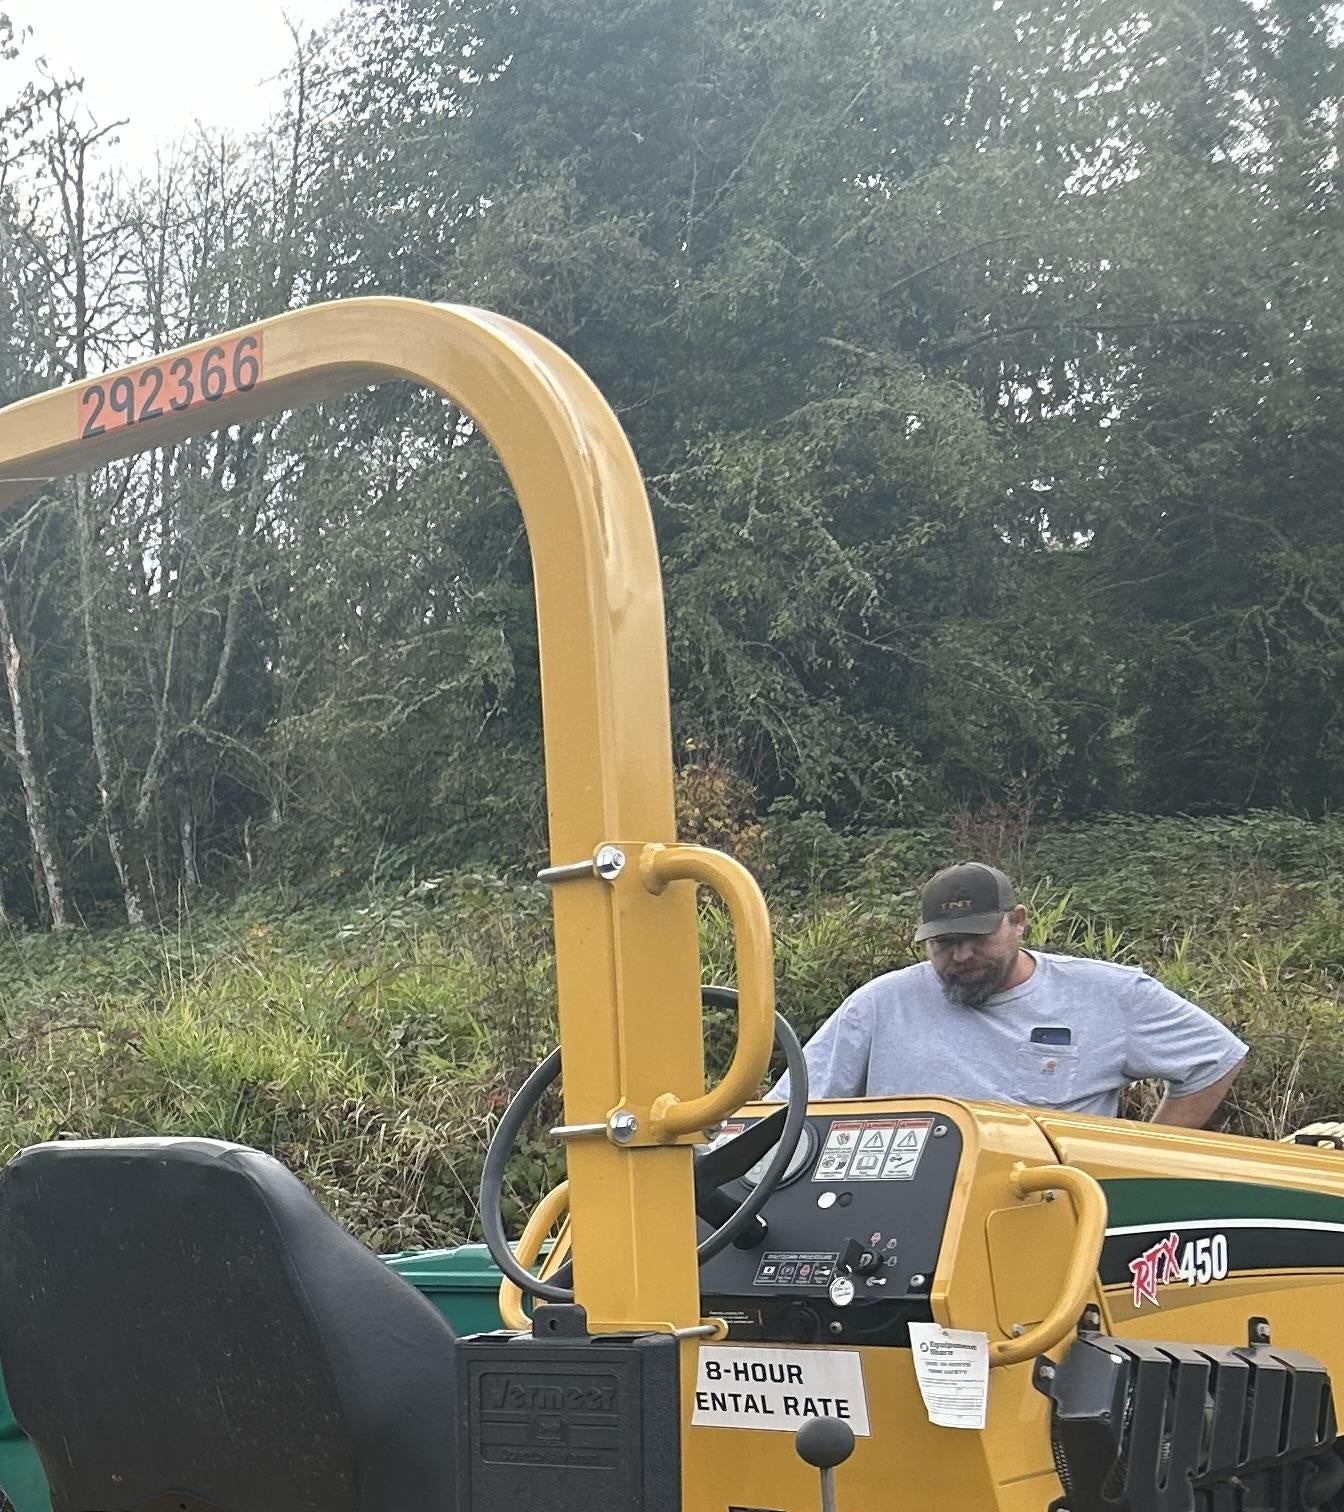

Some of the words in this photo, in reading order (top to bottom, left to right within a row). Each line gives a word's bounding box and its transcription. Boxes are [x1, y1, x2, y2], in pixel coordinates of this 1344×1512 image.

[81, 336, 260, 439] 292366
[706, 1361, 803, 1384] 8-HOUR
[696, 1391, 774, 1415] ENTAL
[783, 1396, 851, 1419] RATE
